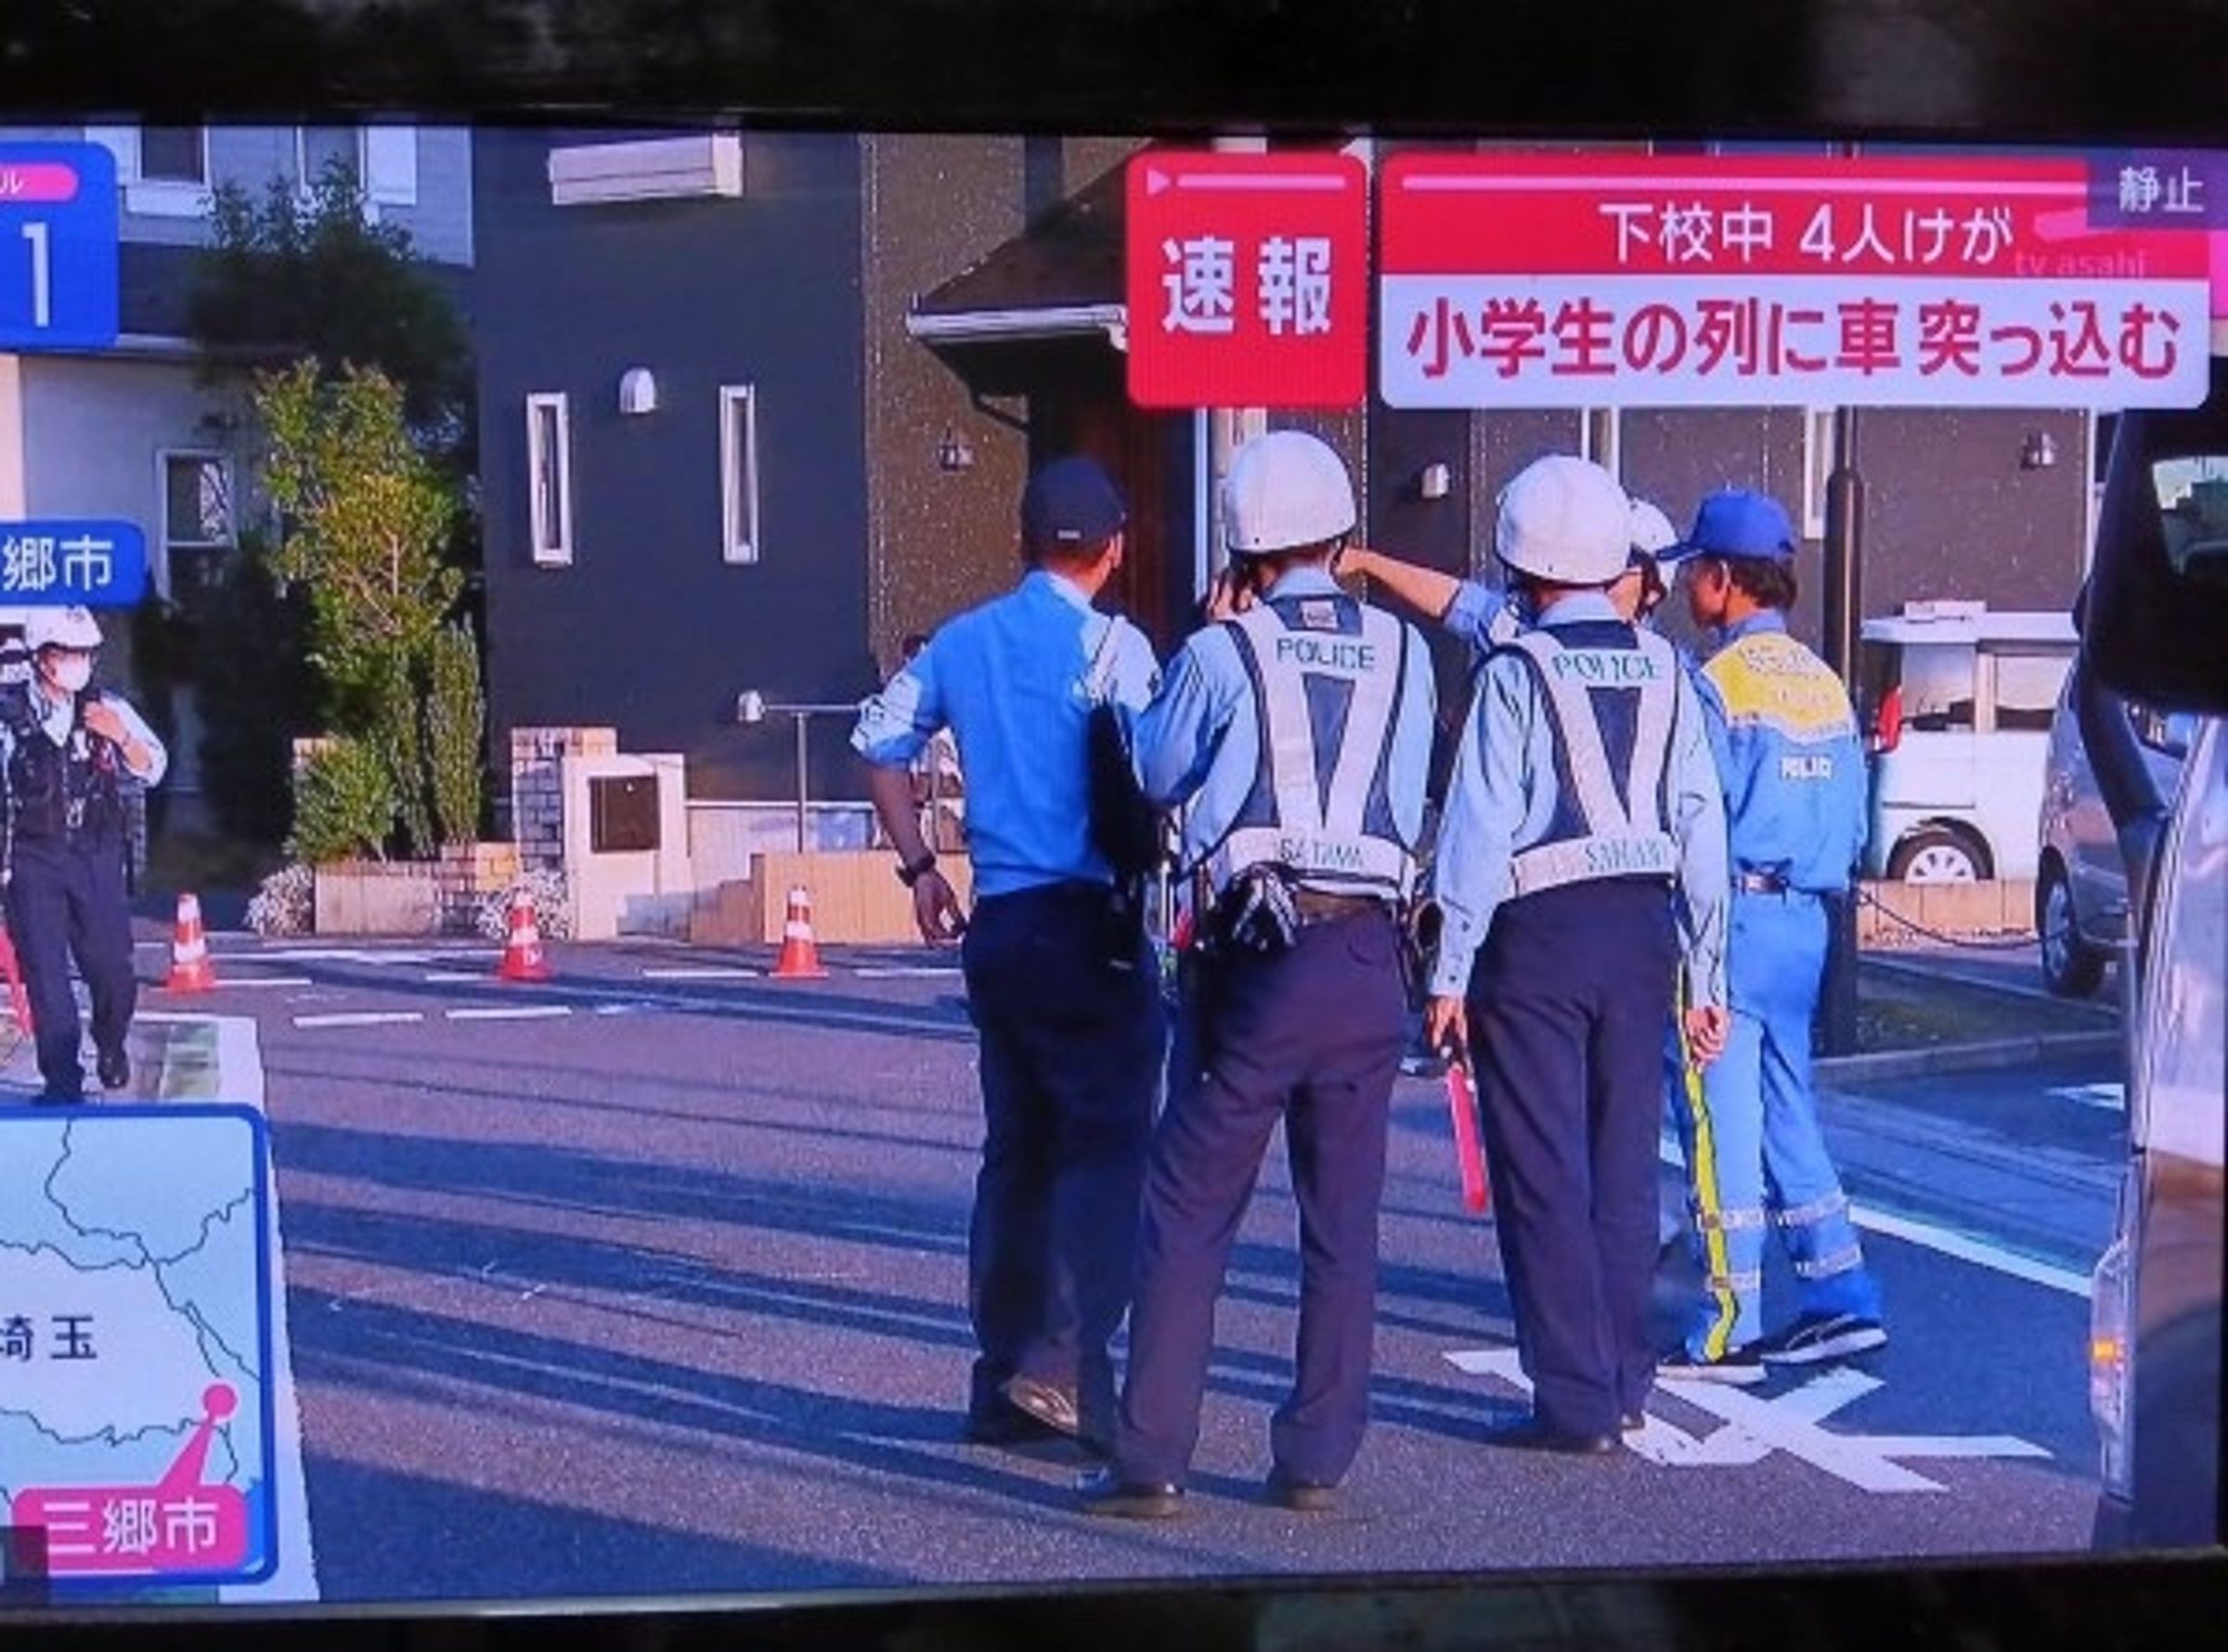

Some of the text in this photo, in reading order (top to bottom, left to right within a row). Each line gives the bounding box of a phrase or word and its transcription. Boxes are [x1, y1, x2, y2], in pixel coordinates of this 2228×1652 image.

[2118, 166, 2205, 213] 静止
[1599, 200, 2014, 265] 下校中 4人けが
[1161, 235, 1331, 336] 速報
[2014, 248, 2147, 277] tv asahi
[3, 534, 114, 591] 郷市
[1276, 638, 1376, 671] POLICE
[1550, 652, 1664, 681] POLICE
[0, 1312, 98, 1362] 埼玉
[43, 1495, 220, 1556] 三郷市
